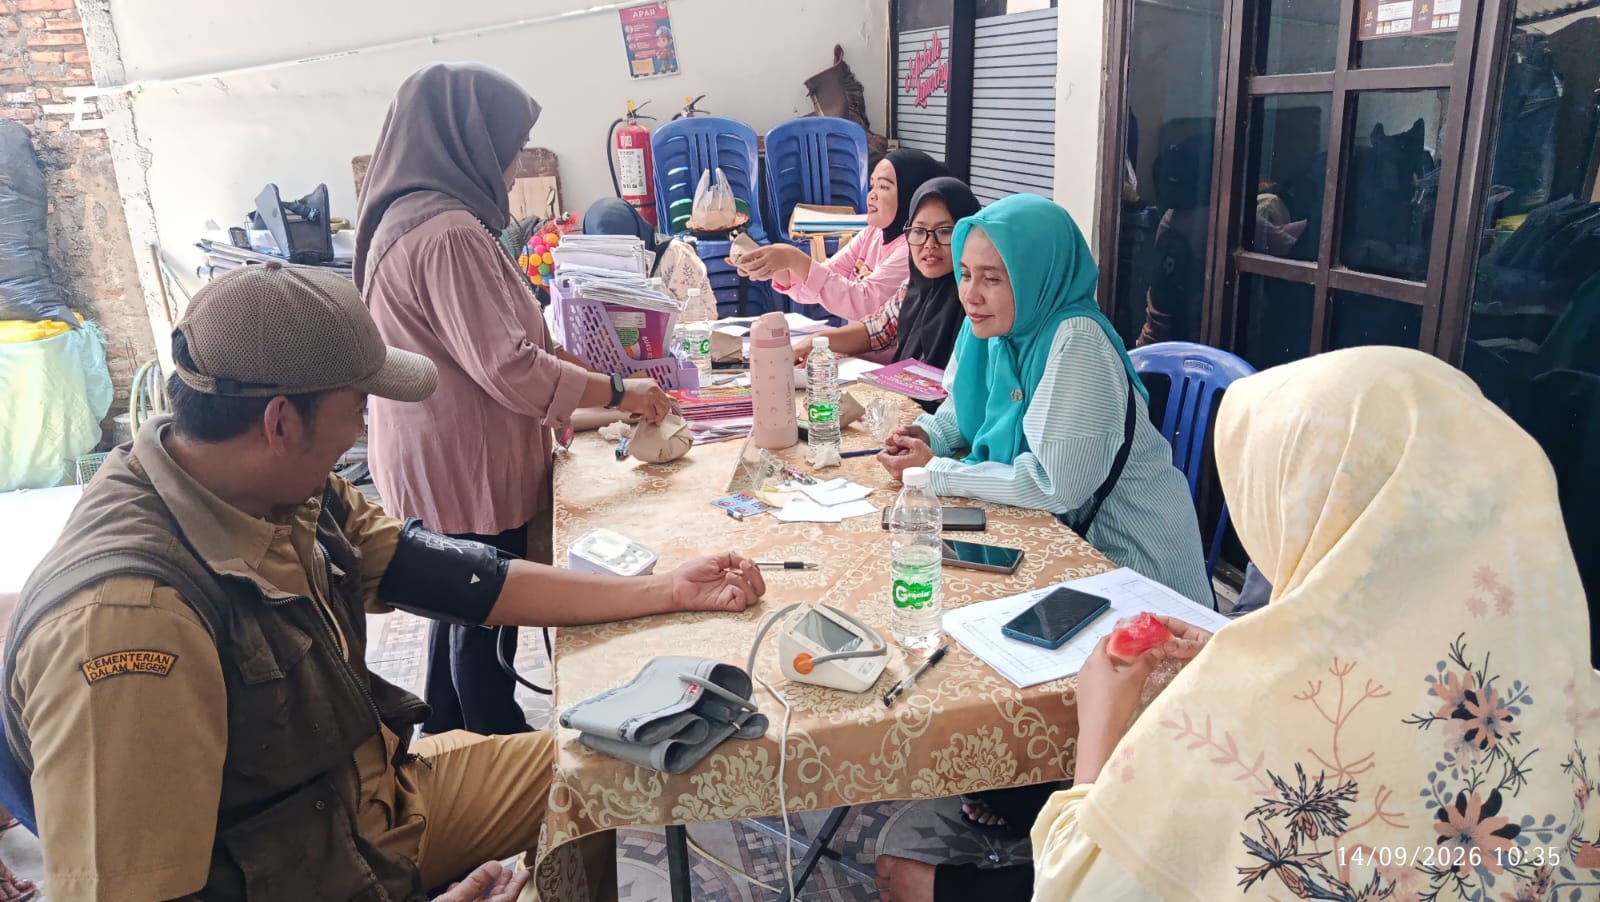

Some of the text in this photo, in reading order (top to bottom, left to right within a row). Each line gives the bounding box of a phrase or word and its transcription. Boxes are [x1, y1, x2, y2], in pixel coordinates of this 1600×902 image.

[632, 9, 656, 18] APAR
[86, 653, 169, 671] KEMENTERIAN
[89, 662, 167, 680] DALAM NEGERI
